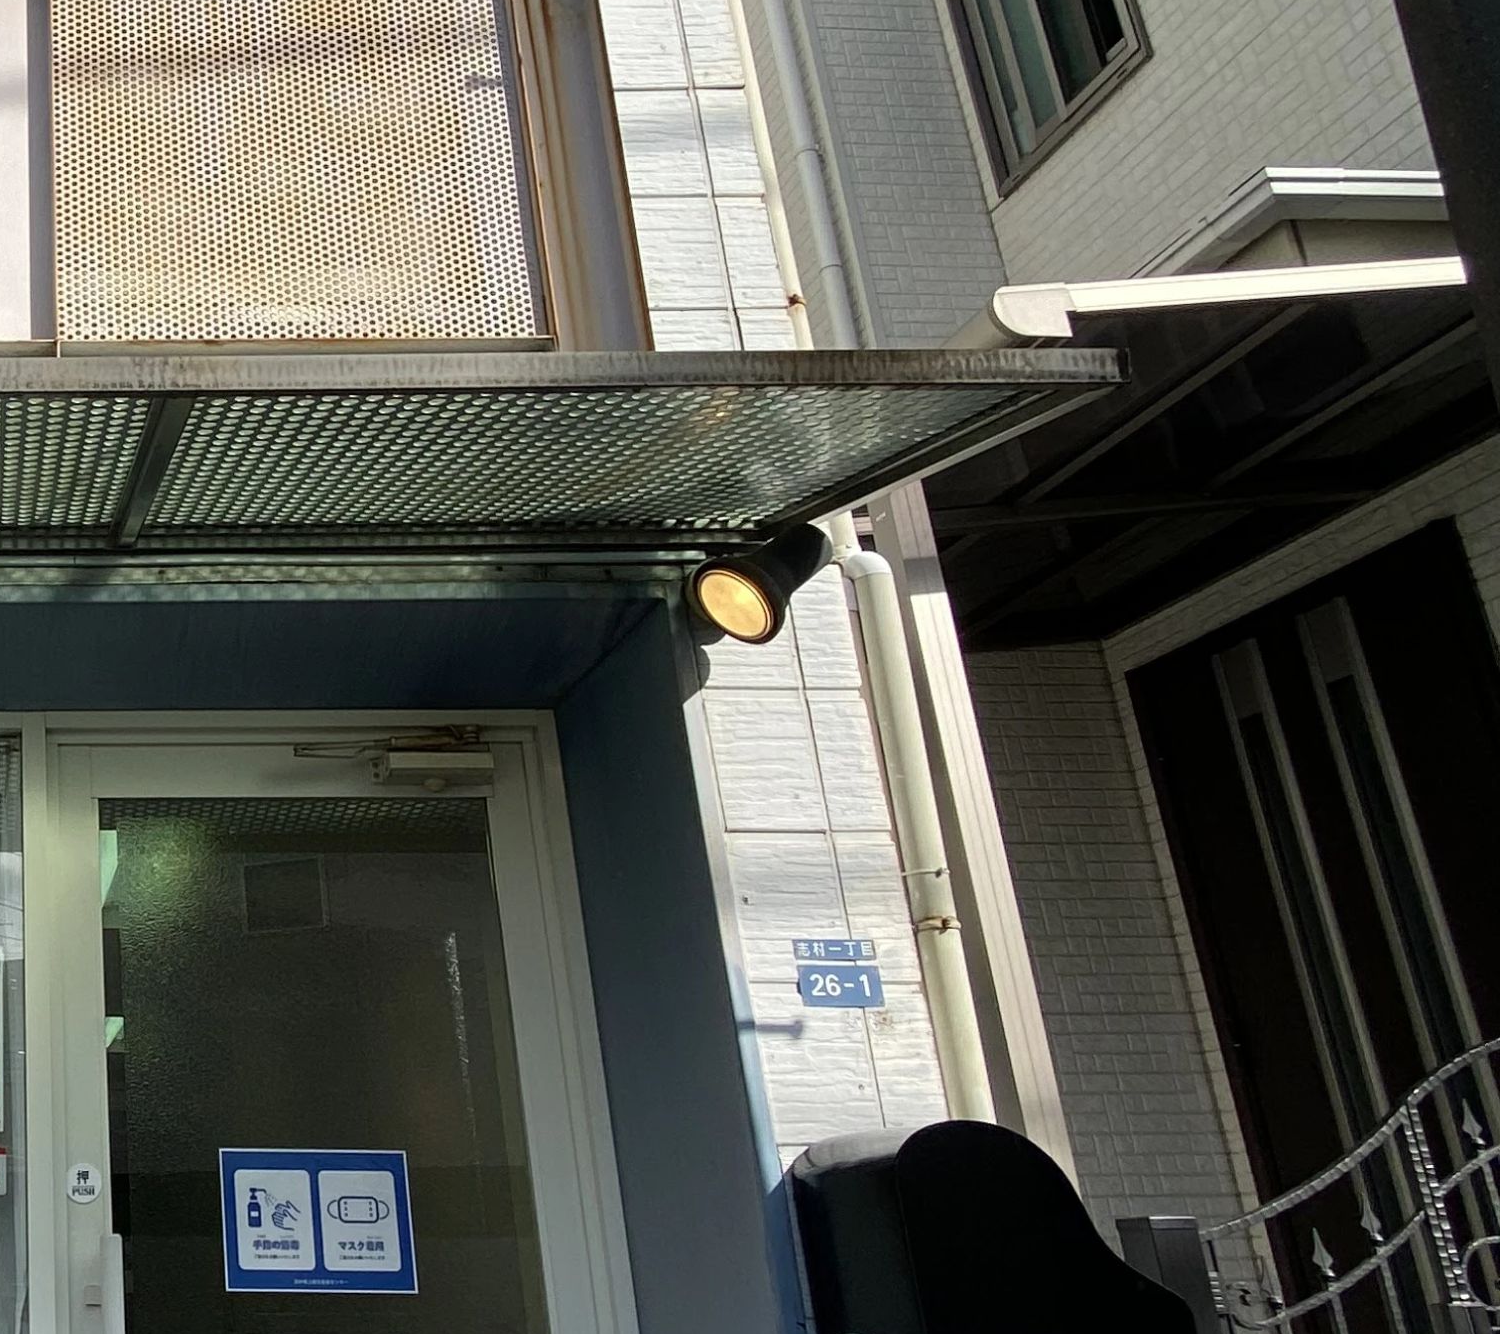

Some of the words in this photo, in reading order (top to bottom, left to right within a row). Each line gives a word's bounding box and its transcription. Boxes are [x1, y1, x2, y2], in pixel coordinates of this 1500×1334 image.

[796, 941, 874, 957] 志村一丁目
[809, 973, 871, 997] 26-1
[76, 1170, 90, 1185] 押
[72, 1185, 95, 1196] PUSH
